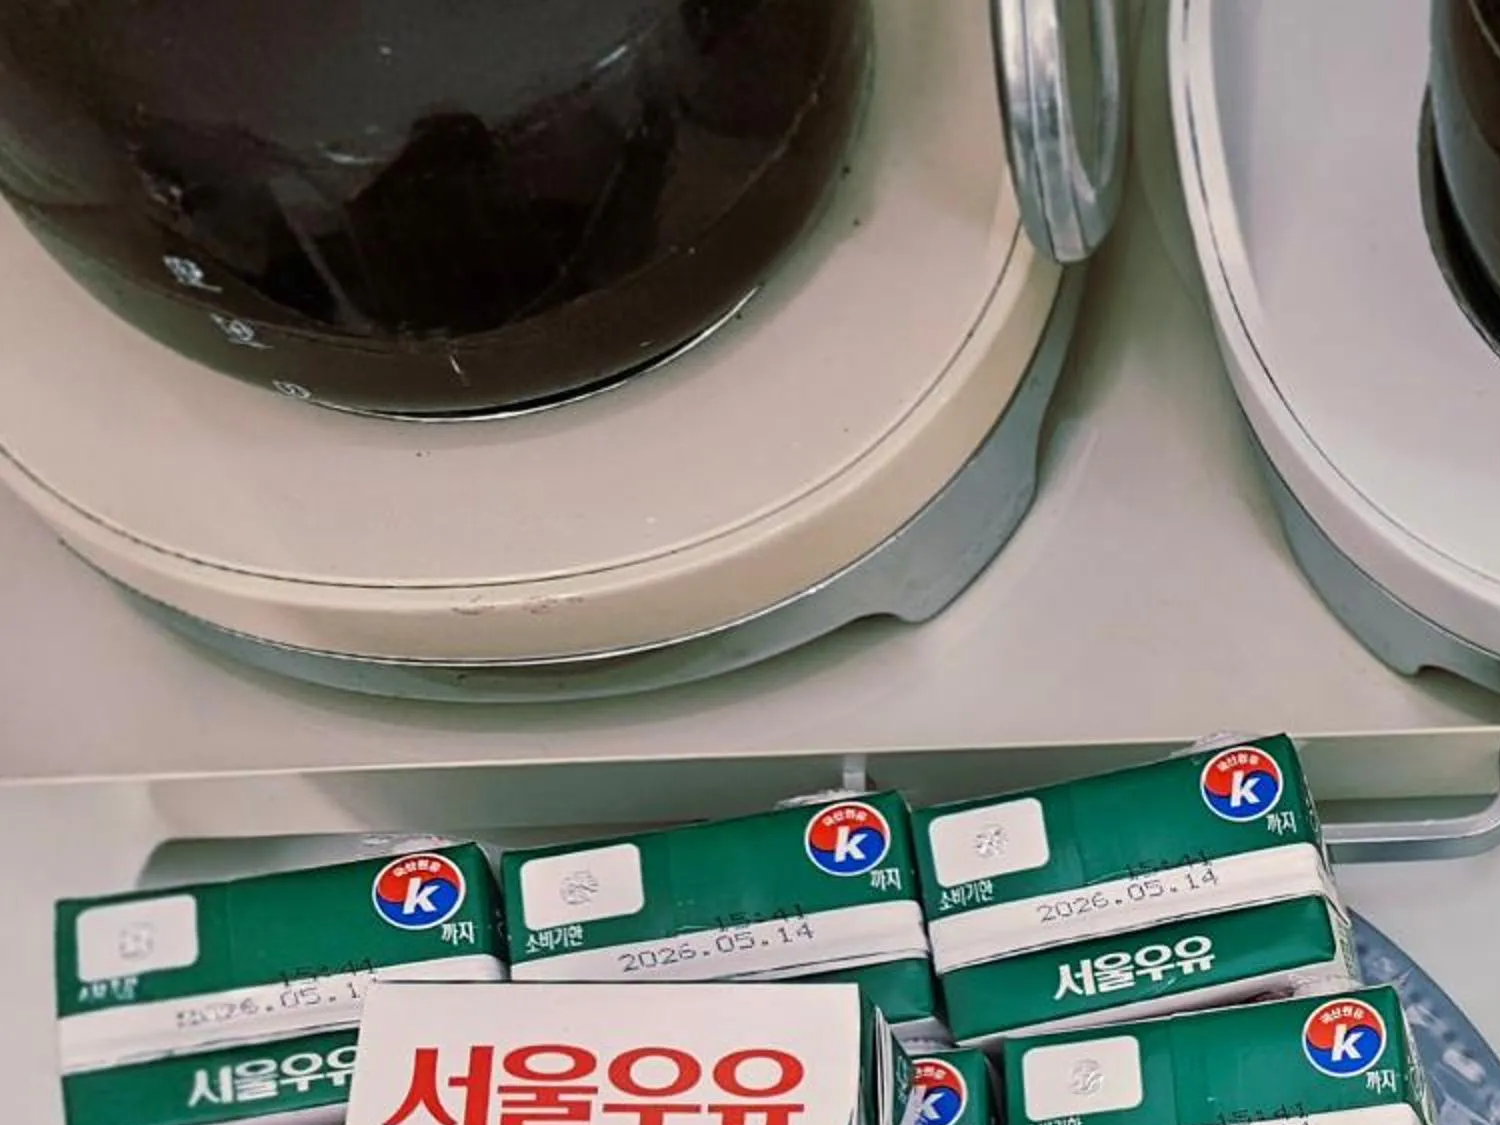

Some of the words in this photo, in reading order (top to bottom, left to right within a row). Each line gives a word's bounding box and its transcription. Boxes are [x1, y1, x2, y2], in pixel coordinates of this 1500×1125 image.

[1266, 812, 1297, 836] 까지
[870, 868, 900, 891] 까지
[1037, 868, 1219, 923] 2026.05.14
[441, 921, 475, 946] 까지
[618, 922, 815, 973] 2026.05.14
[1054, 935, 1215, 1000] 서울우유
[1365, 1069, 1396, 1095] 까지
